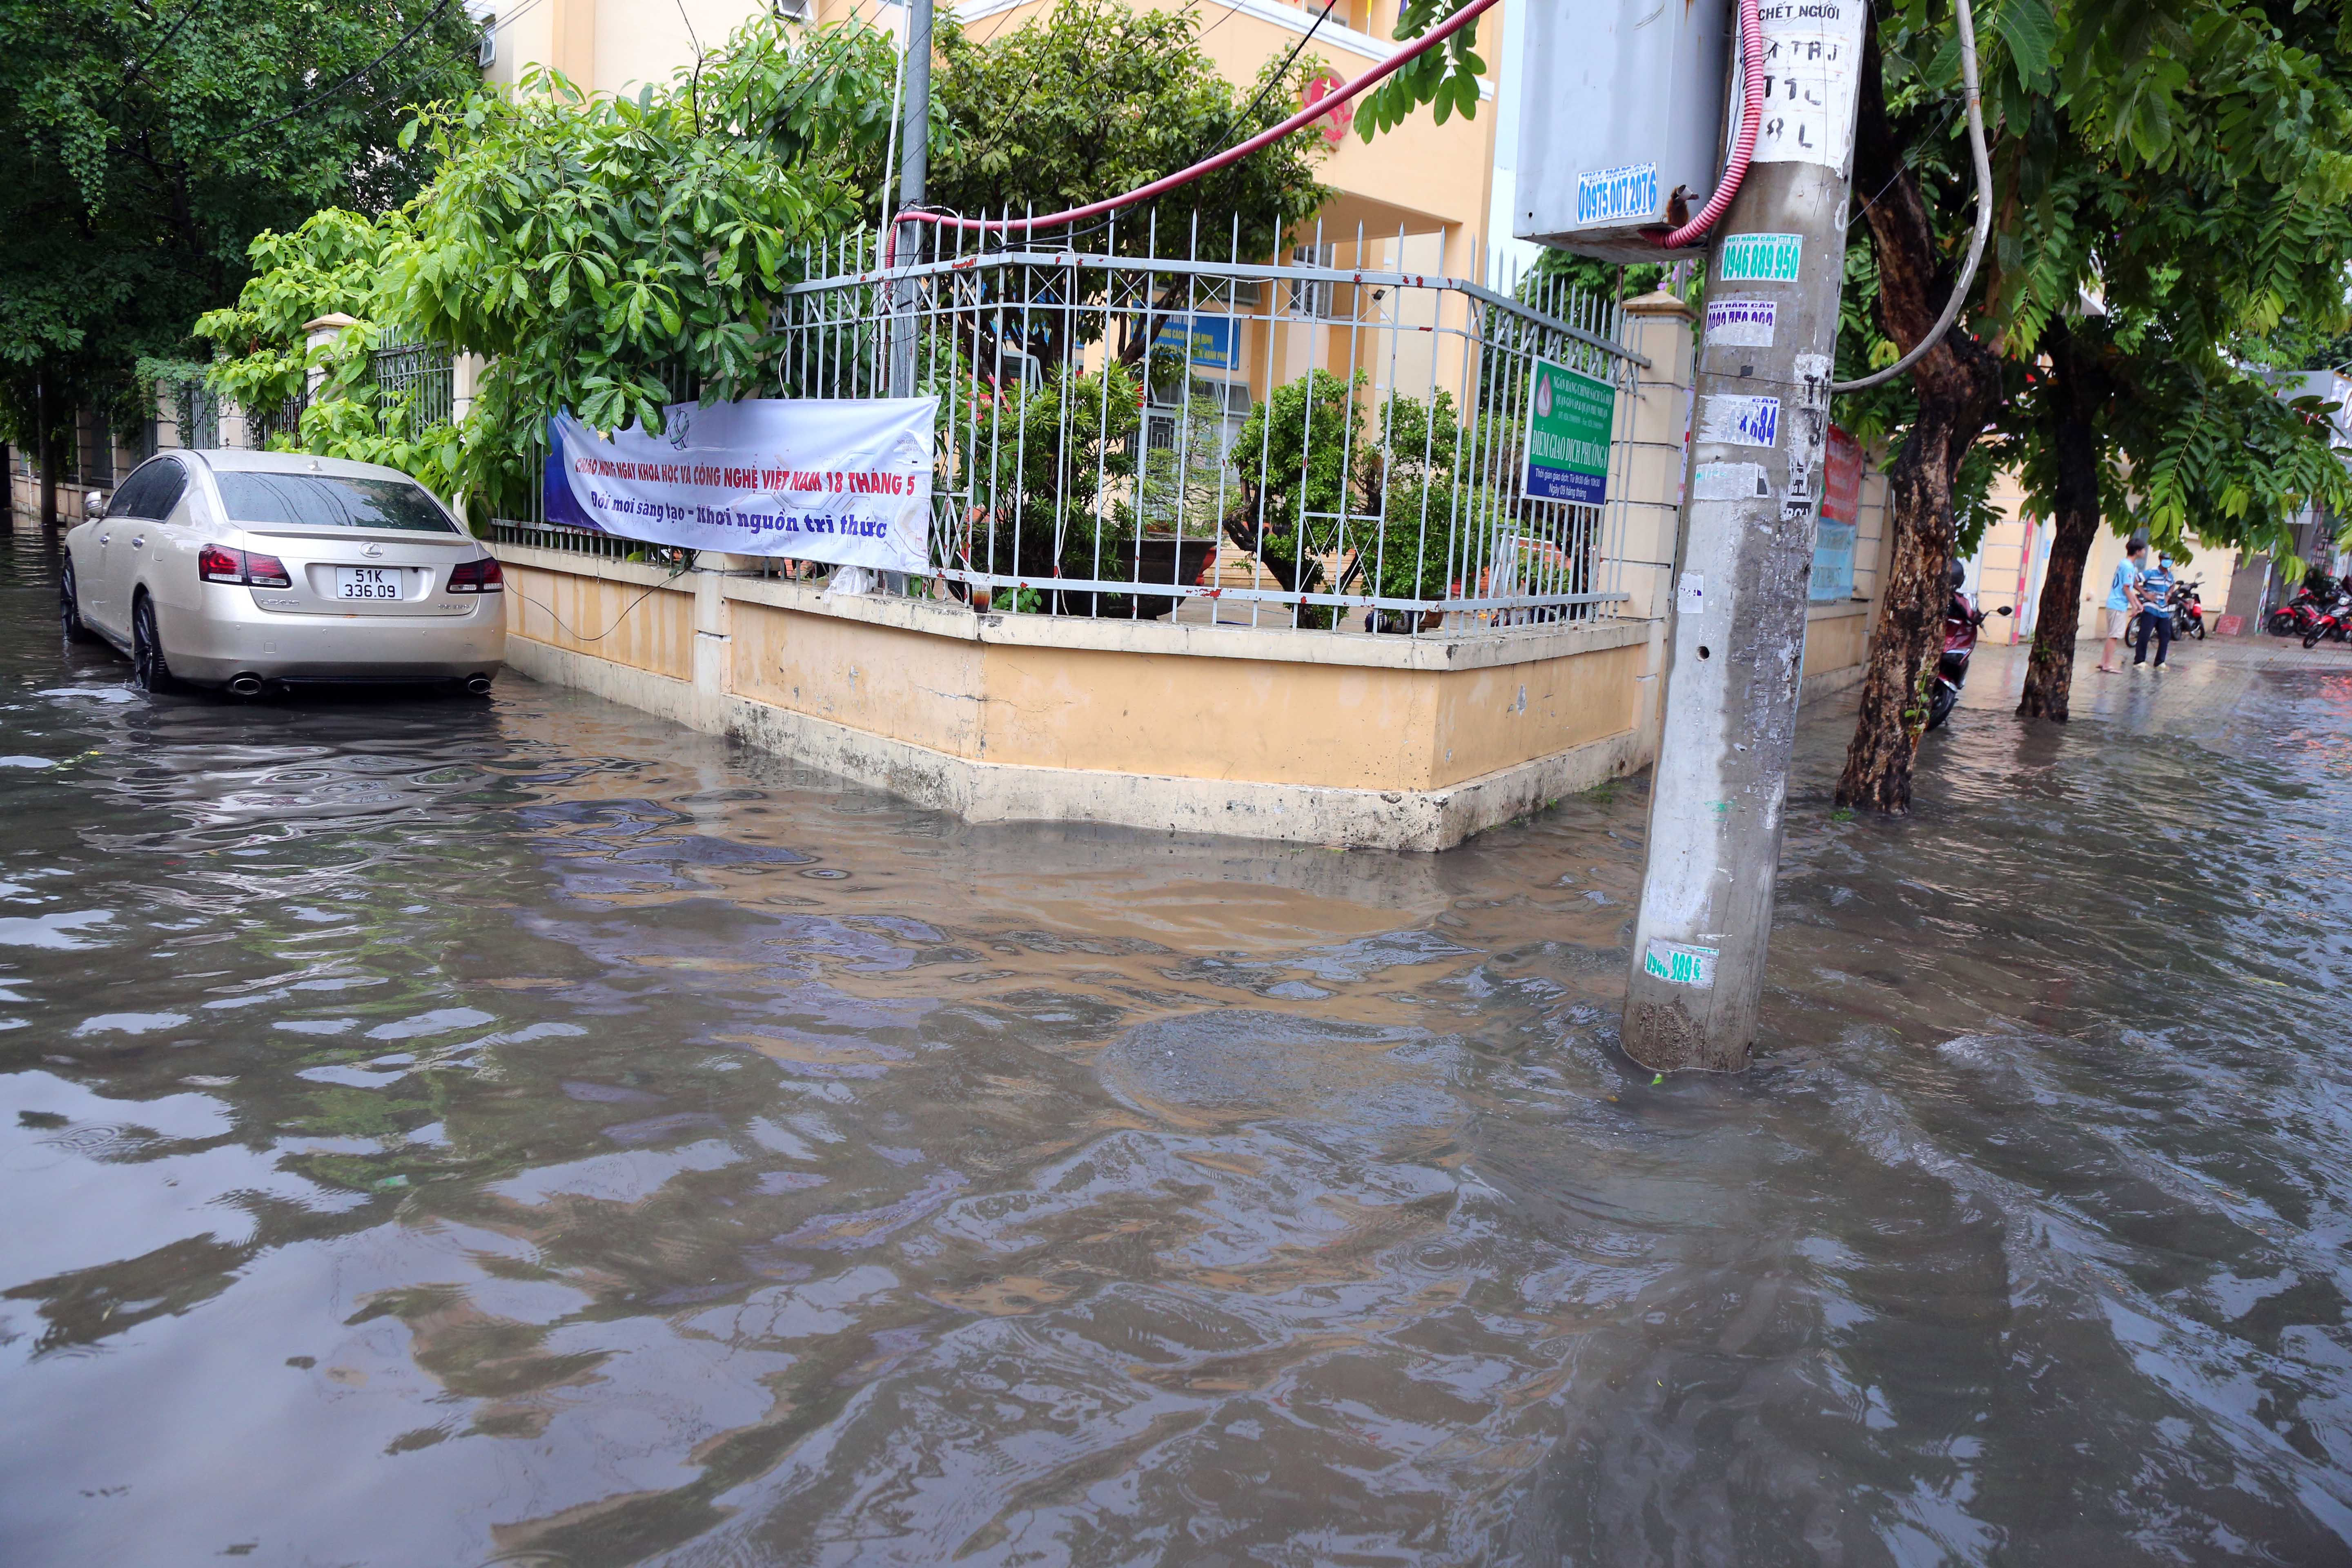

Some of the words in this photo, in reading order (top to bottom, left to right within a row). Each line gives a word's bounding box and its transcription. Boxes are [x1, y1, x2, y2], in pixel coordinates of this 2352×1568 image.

[1759, 2, 1793, 20] CHẾT
[1799, 3, 1839, 20] NGƯỜI
[1724, 244, 1799, 280] 0946.889.950
[1532, 423, 1550, 457] ĐIỂM
[1550, 434, 1566, 461] GIAO
[1565, 438, 1581, 468] DỊCH
[1581, 437, 1604, 469] PHƯỜNG
[1604, 446, 1608, 469] 8
[575, 455, 597, 474] CHÀO
[598, 457, 617, 478] MỪNG
[617, 459, 636, 480] NGÀY
[638, 463, 660, 483] KHOA
[662, 464, 678, 488] HỌC
[680, 462, 691, 484] VÀ
[694, 462, 721, 487] CÔNG
[724, 465, 758, 494] NGHỆ
[762, 466, 790, 495] VIỆT
[790, 471, 823, 492] NAM
[826, 471, 843, 493] 18
[848, 468, 902, 495] THÁNG
[906, 476, 915, 496] 5
[1535, 468, 1544, 480] Thời
[1544, 470, 1552, 481] gian
[1552, 471, 1561, 482] giao
[1549, 483, 1560, 497] Ngày
[1566, 486, 1575, 499] hàng
[1576, 488, 1586, 500] tháng
[591, 490, 611, 509] Đổi
[612, 496, 635, 514] mới
[637, 499, 664, 523] sáng
[666, 502, 685, 524] tạo
[696, 504, 732, 526] Khơi
[737, 508, 799, 534] nguồn
[804, 513, 834, 533] tri
[840, 514, 887, 538] thức
[355, 569, 383, 583] 51K
[345, 584, 396, 598] 336.09
